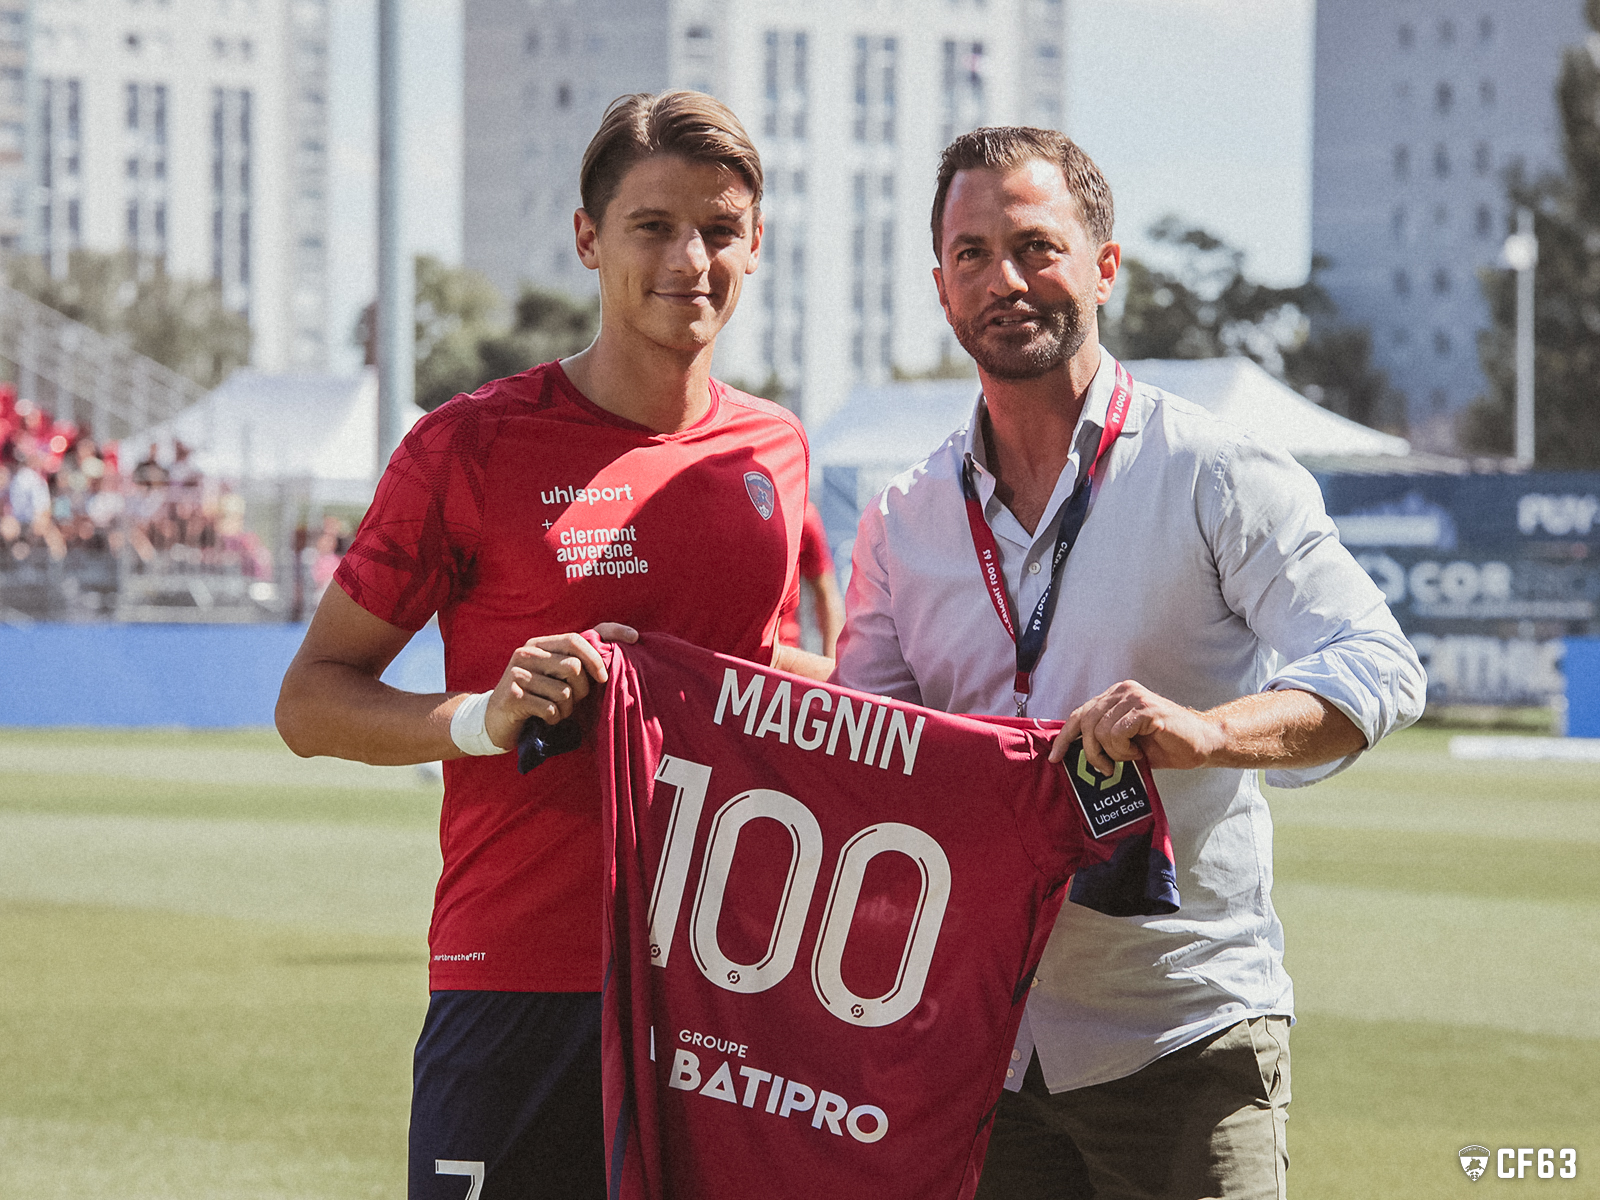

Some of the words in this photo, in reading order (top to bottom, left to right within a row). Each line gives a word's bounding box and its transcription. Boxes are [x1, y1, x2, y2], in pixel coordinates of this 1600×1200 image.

[540, 483, 634, 506] uhlsport
[560, 525, 637, 545] clermont
[556, 543, 633, 562] auvergne
[985, 562, 998, 586] FOOT
[713, 668, 926, 775] MAGNIN
[1093, 789, 1128, 811] LIGUE
[1129, 787, 1137, 796] 1
[1095, 809, 1120, 825] Uber
[1120, 799, 1145, 815] Eats
[647, 754, 952, 1027] 100
[679, 1029, 748, 1058] GROUPE
[668, 1048, 889, 1143] BATIPRO
[435, 1159, 485, 1200] 7
